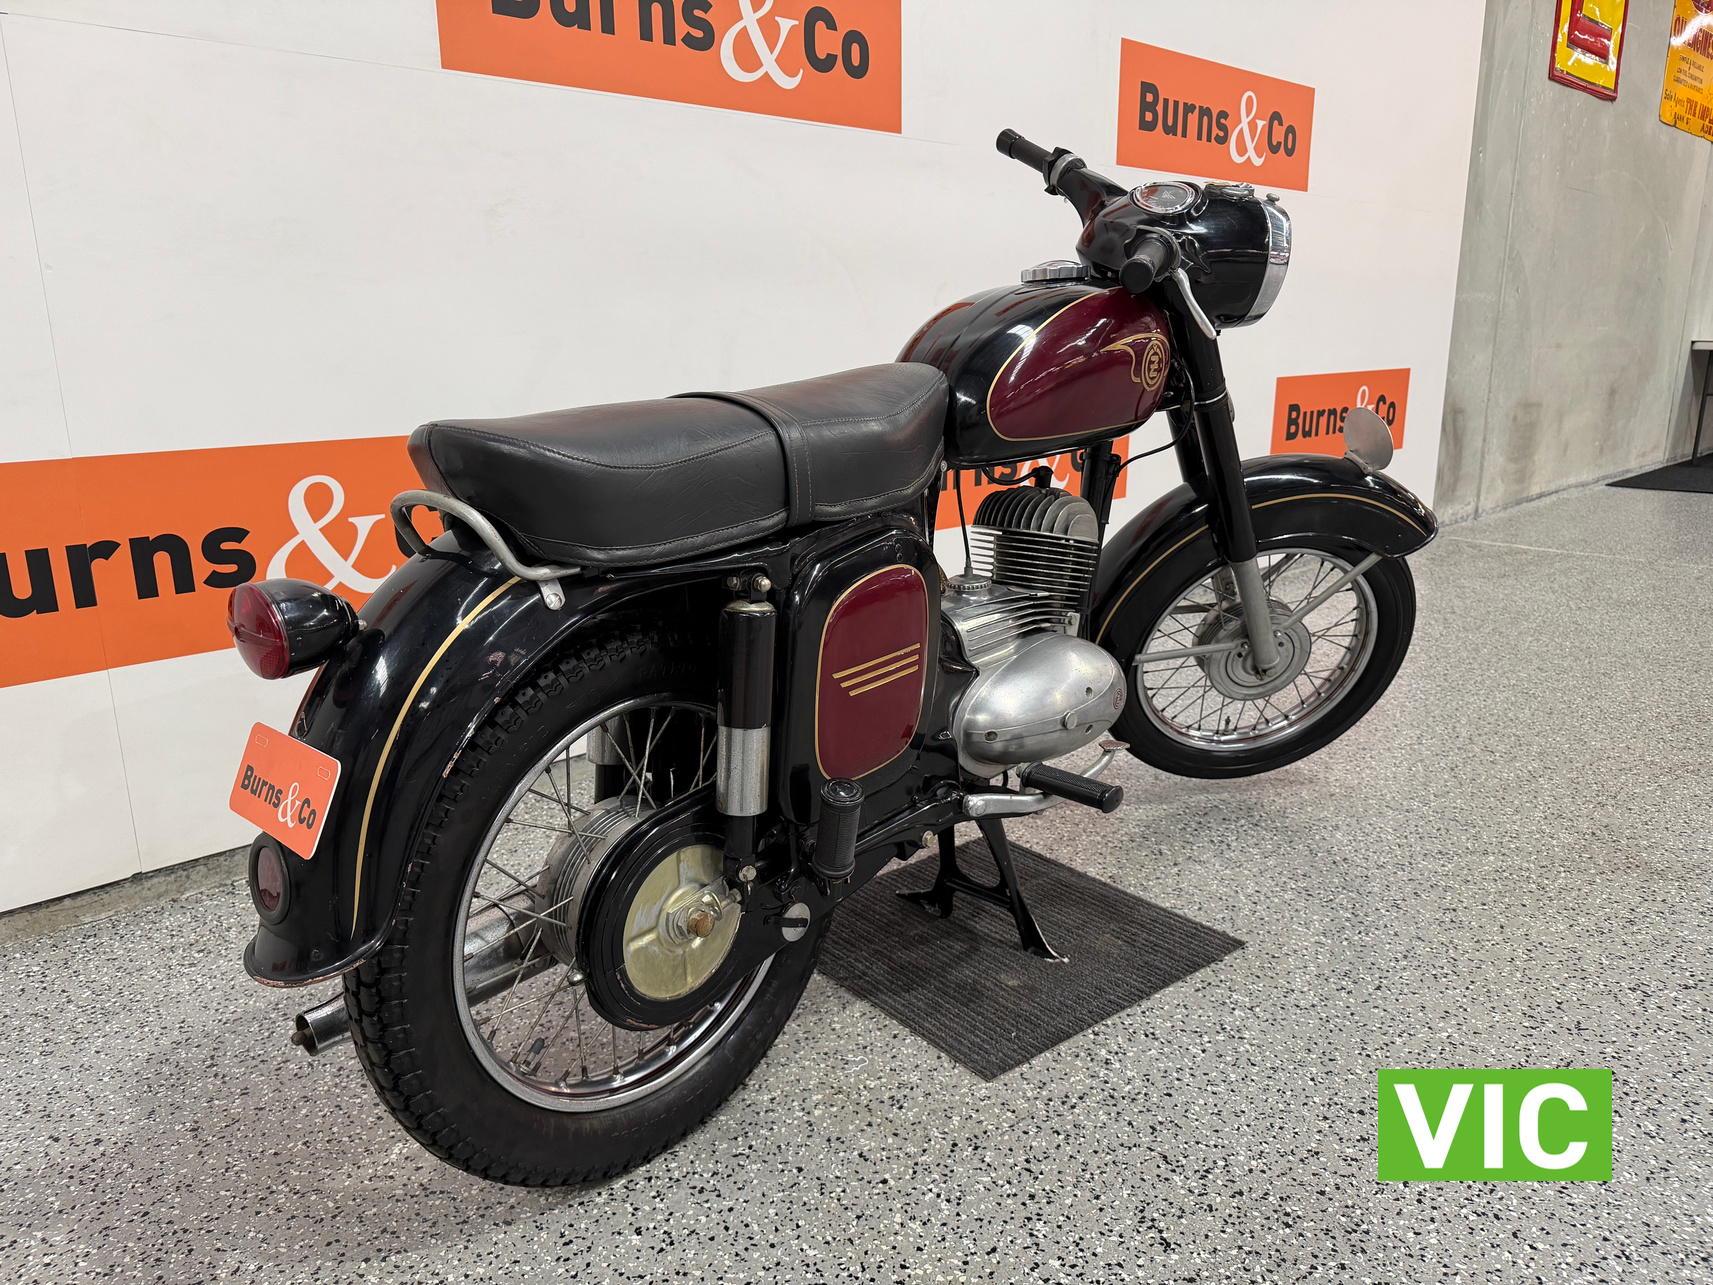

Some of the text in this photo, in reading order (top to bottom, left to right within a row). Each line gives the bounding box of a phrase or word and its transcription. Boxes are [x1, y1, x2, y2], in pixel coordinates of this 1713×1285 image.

[492, 0, 870, 90] urns&Co
[1138, 80, 1297, 167] Burns&Co
[1685, 97, 1698, 117] THE
[240, 764, 317, 830] Burns&Co
